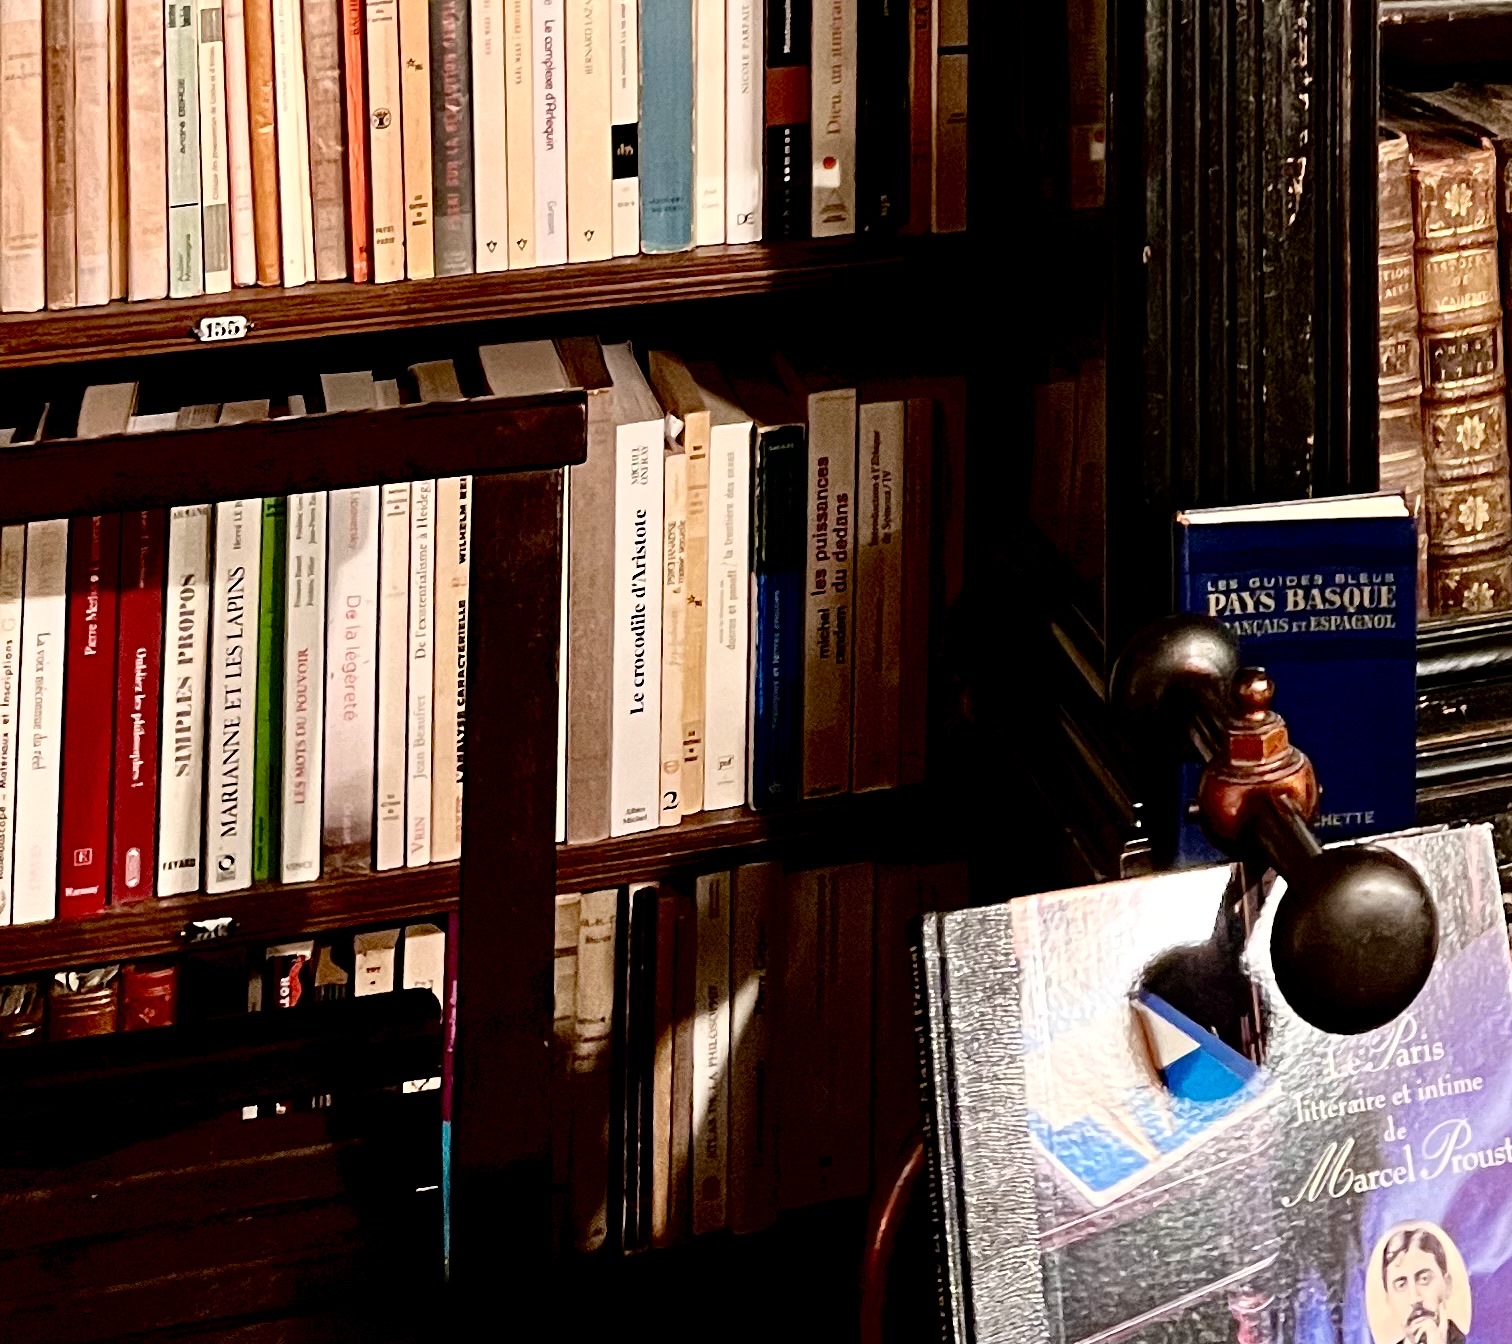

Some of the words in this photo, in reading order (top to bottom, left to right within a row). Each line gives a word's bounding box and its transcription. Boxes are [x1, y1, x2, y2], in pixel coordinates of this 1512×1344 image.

[542, 19, 555, 33] Le
[741, 5, 750, 49] PARFAIT
[541, 36, 555, 90] complexe
[583, 27, 594, 75] BERNARD
[741, 54, 750, 95] NICOLE
[829, 64, 842, 85] un
[542, 93, 556, 151] d'Arlequin
[827, 95, 843, 135] Dieu,
[177, 121, 187, 155] André
[207, 319, 241, 338] 155
[631, 447, 640, 486] MICHEL
[639, 445, 650, 486] ONFRAY
[812, 456, 831, 562] puissances
[458, 505, 468, 565] WILHELM
[832, 492, 849, 563] dedans
[631, 509, 648, 599] d'Aristote
[414, 543, 428, 638] l'existentialisme
[810, 568, 827, 596] les
[833, 568, 849, 593] du
[1206, 579, 1239, 592] LES
[1249, 574, 1324, 589] GUIDES
[227, 565, 245, 639] LAPINS
[345, 595, 361, 620] De
[1206, 590, 1276, 617] PAYS
[1285, 585, 1397, 613] BASQUE
[176, 573, 197, 665] PROPOS
[344, 625, 360, 640] la
[818, 608, 831, 659] michel
[1309, 614, 1397, 632] ESPAGNOL
[36, 631, 51, 647] La
[84, 624, 97, 656] Pierre
[414, 641, 427, 660] De
[630, 603, 647, 688] crocodile
[1, 639, 13, 707] Inscriptions
[33, 649, 46, 673] voix
[225, 645, 243, 678] LES
[296, 647, 309, 713] POUVOIR
[341, 646, 361, 722] légèreté
[132, 694, 145, 710] les
[224, 687, 242, 710] ET
[629, 693, 645, 715] Le
[1, 714, 10, 725] et
[174, 677, 194, 778] SIMPLES
[295, 716, 307, 737] DU
[413, 694, 427, 747] Beaufret
[32, 733, 47, 748] du
[293, 739, 307, 777] MOTS
[413, 749, 427, 779] Jean
[220, 718, 240, 838] MARIANNE
[293, 779, 306, 805] LES
[1314, 1045, 1359, 1079] Le
[1363, 1012, 1445, 1074] Paris
[708, 1071, 719, 1090] LA
[1392, 1087, 1411, 1106] et
[1417, 1075, 1483, 1101] intime
[1383, 1116, 1407, 1143] de
[1281, 1137, 1417, 1208] Marcel
